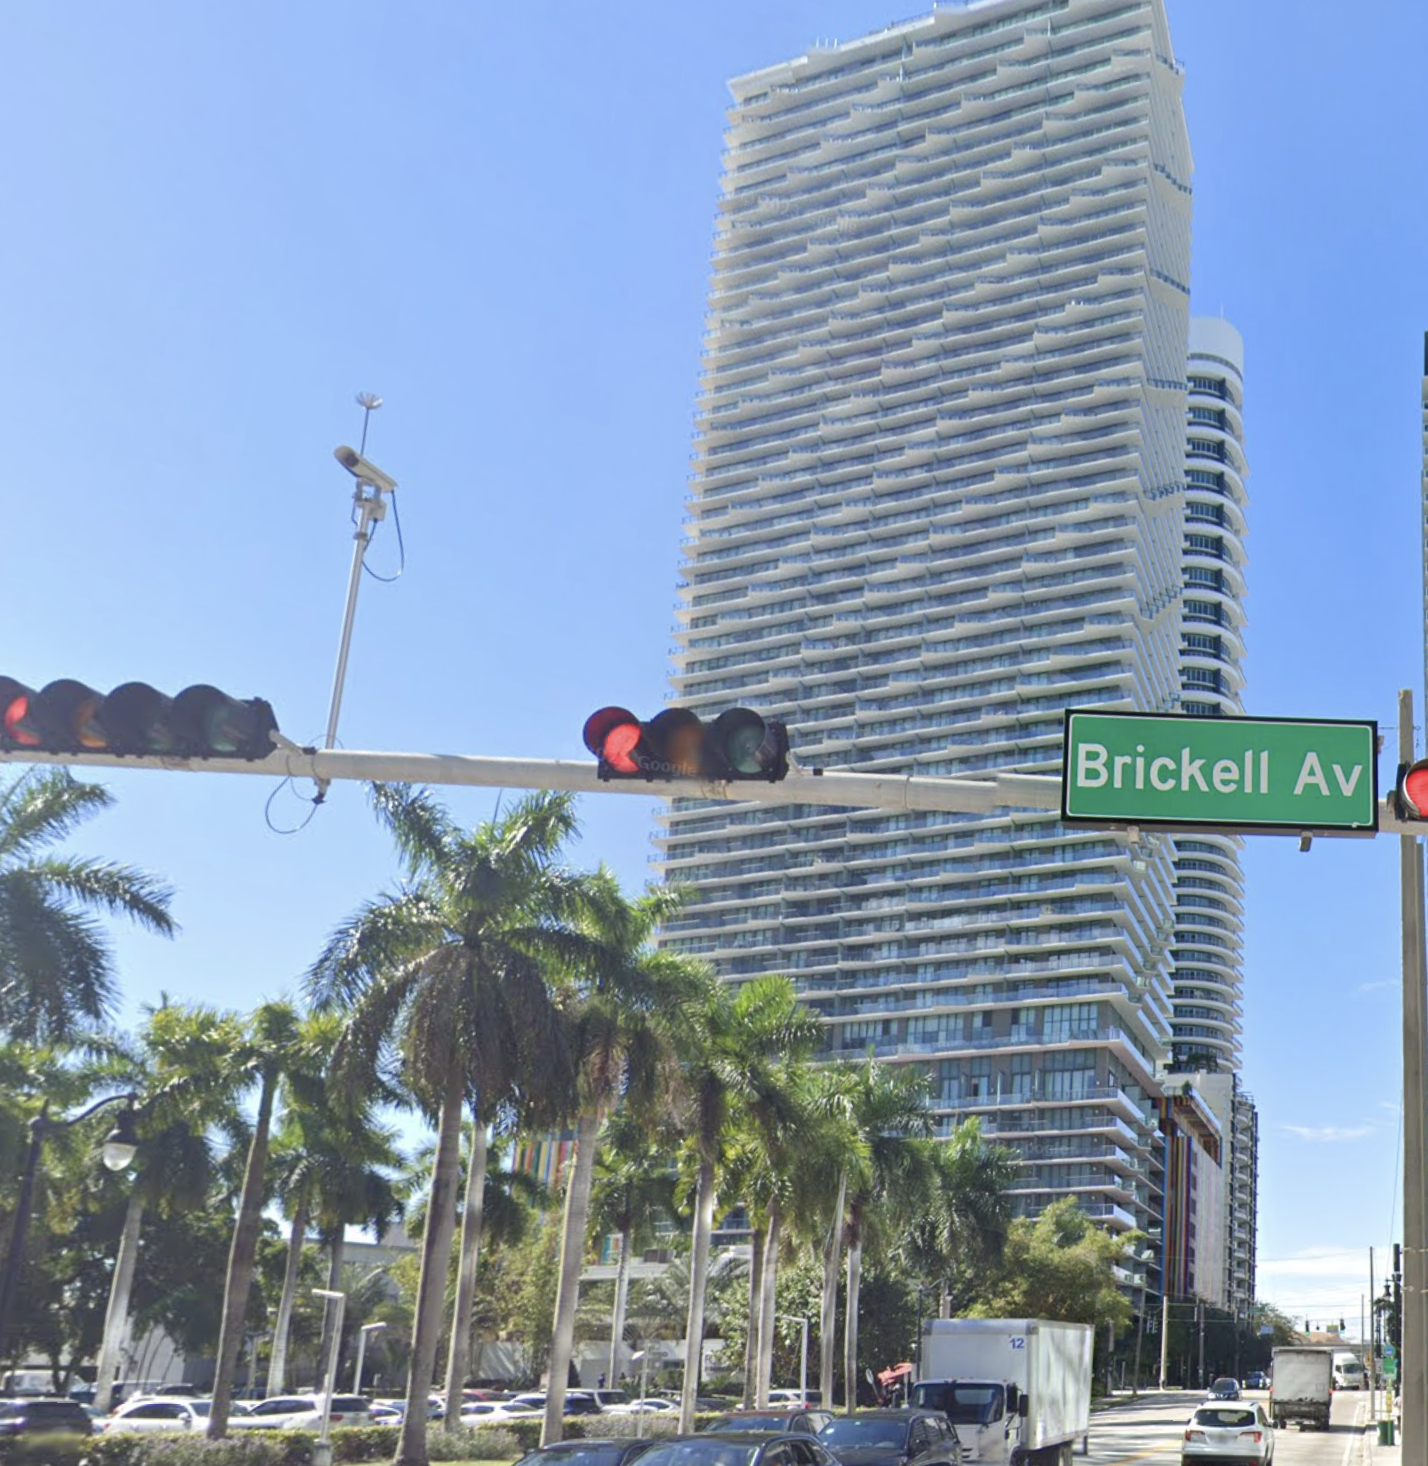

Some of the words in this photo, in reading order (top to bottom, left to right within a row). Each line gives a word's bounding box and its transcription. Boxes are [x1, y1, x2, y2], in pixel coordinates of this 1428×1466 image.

[1076, 742, 1268, 794] Brickell
[1293, 751, 1363, 797] Av
[1009, 1337, 1025, 1349] 12
